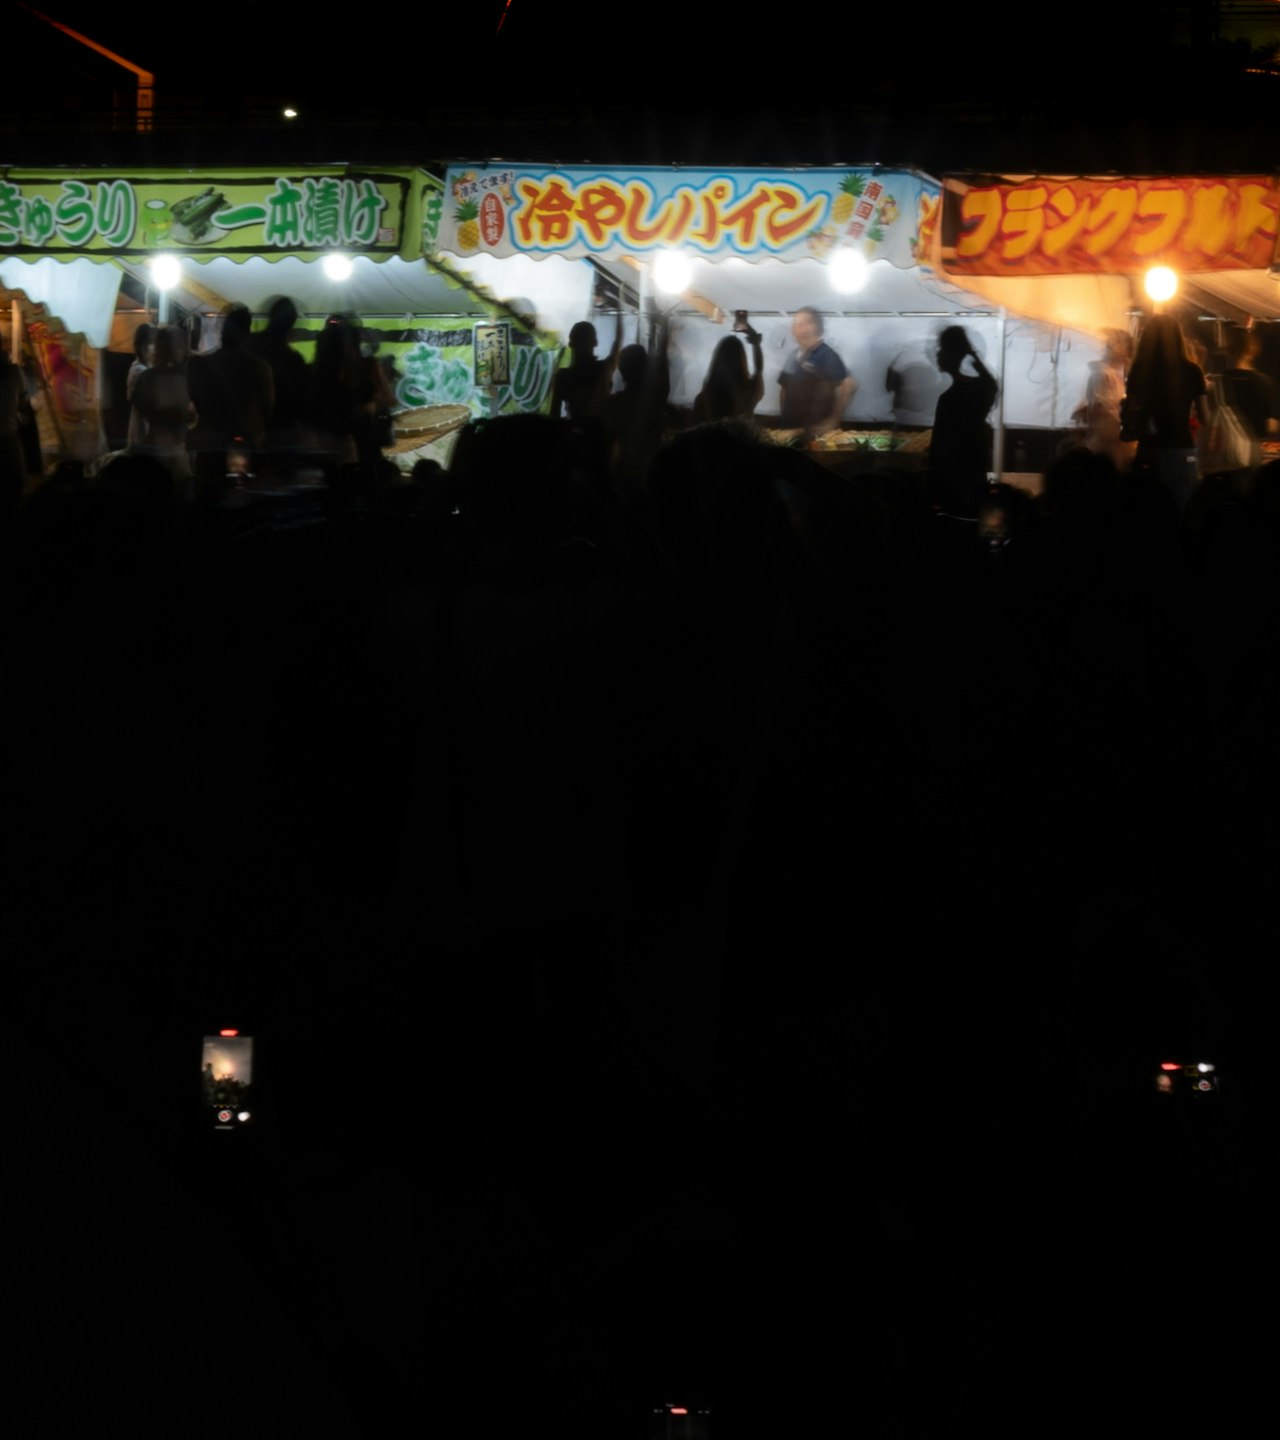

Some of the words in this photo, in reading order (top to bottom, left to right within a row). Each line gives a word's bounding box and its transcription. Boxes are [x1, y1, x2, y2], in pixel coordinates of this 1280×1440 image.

[213, 178, 387, 247] 一本漬け
[516, 177, 823, 249] 冷やしパイン
[956, 183, 1279, 262] フランクフルト
[397, 342, 555, 413] きゅり
